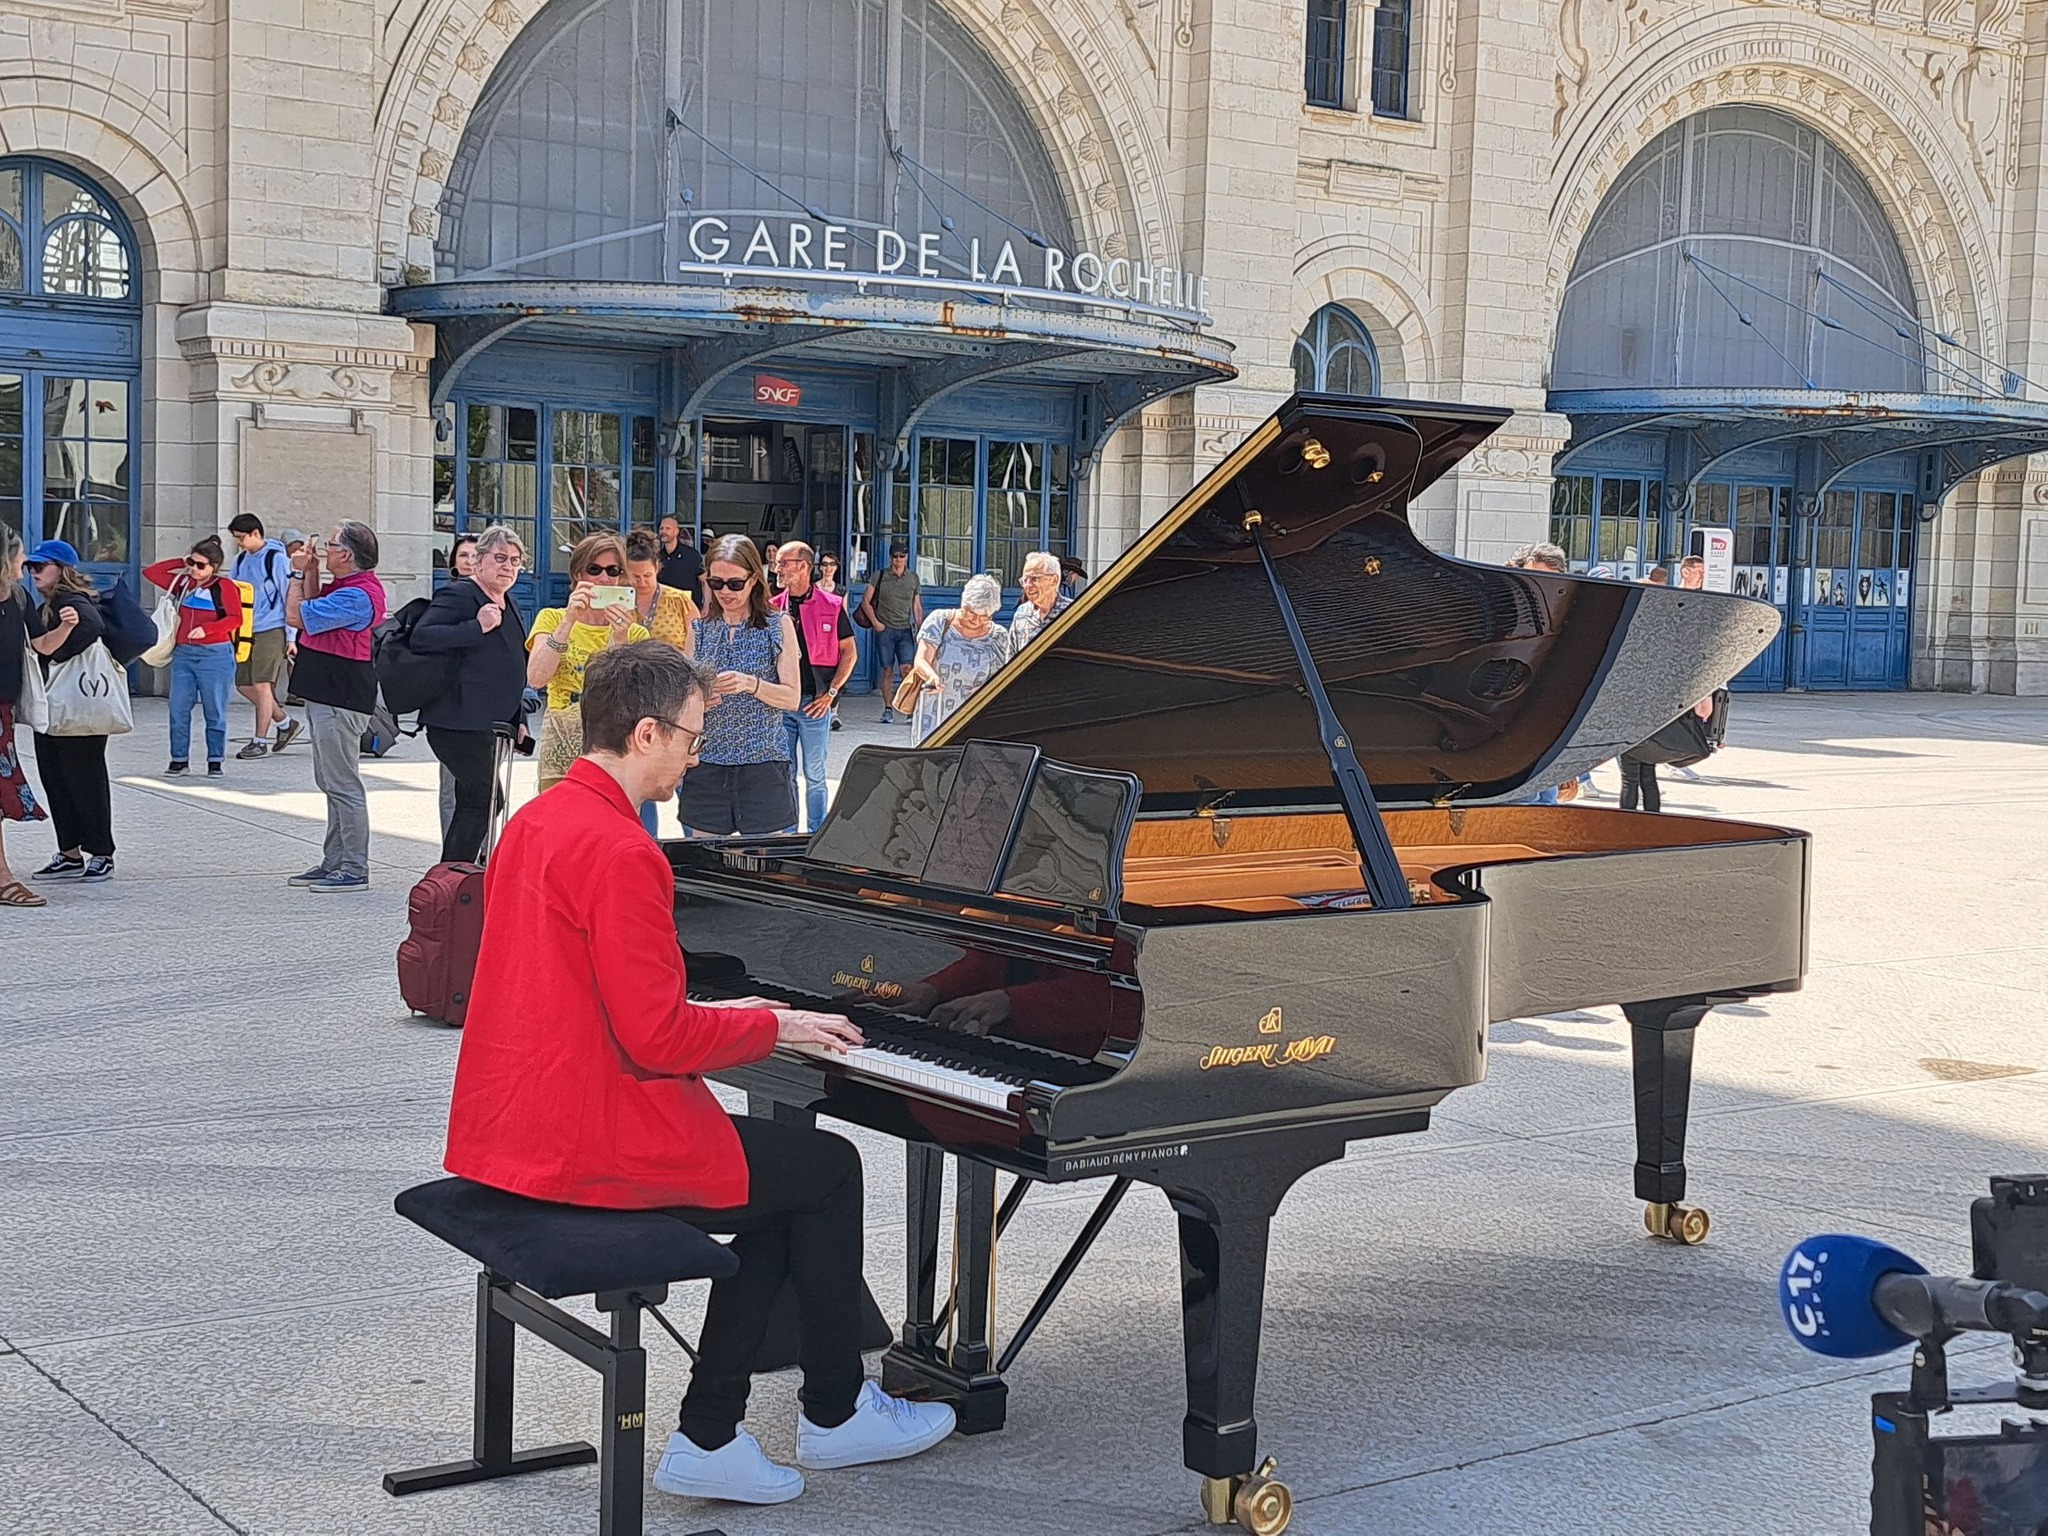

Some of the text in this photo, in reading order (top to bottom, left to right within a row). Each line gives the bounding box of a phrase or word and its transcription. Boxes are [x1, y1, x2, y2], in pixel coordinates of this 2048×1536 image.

[689, 217, 1210, 315] GARE DE LA ROCHELLE
[756, 386, 799, 402] SNCF
[1200, 1035, 1337, 1070] SHIGERU KAWAI
[1787, 1250, 1817, 1337] C17
